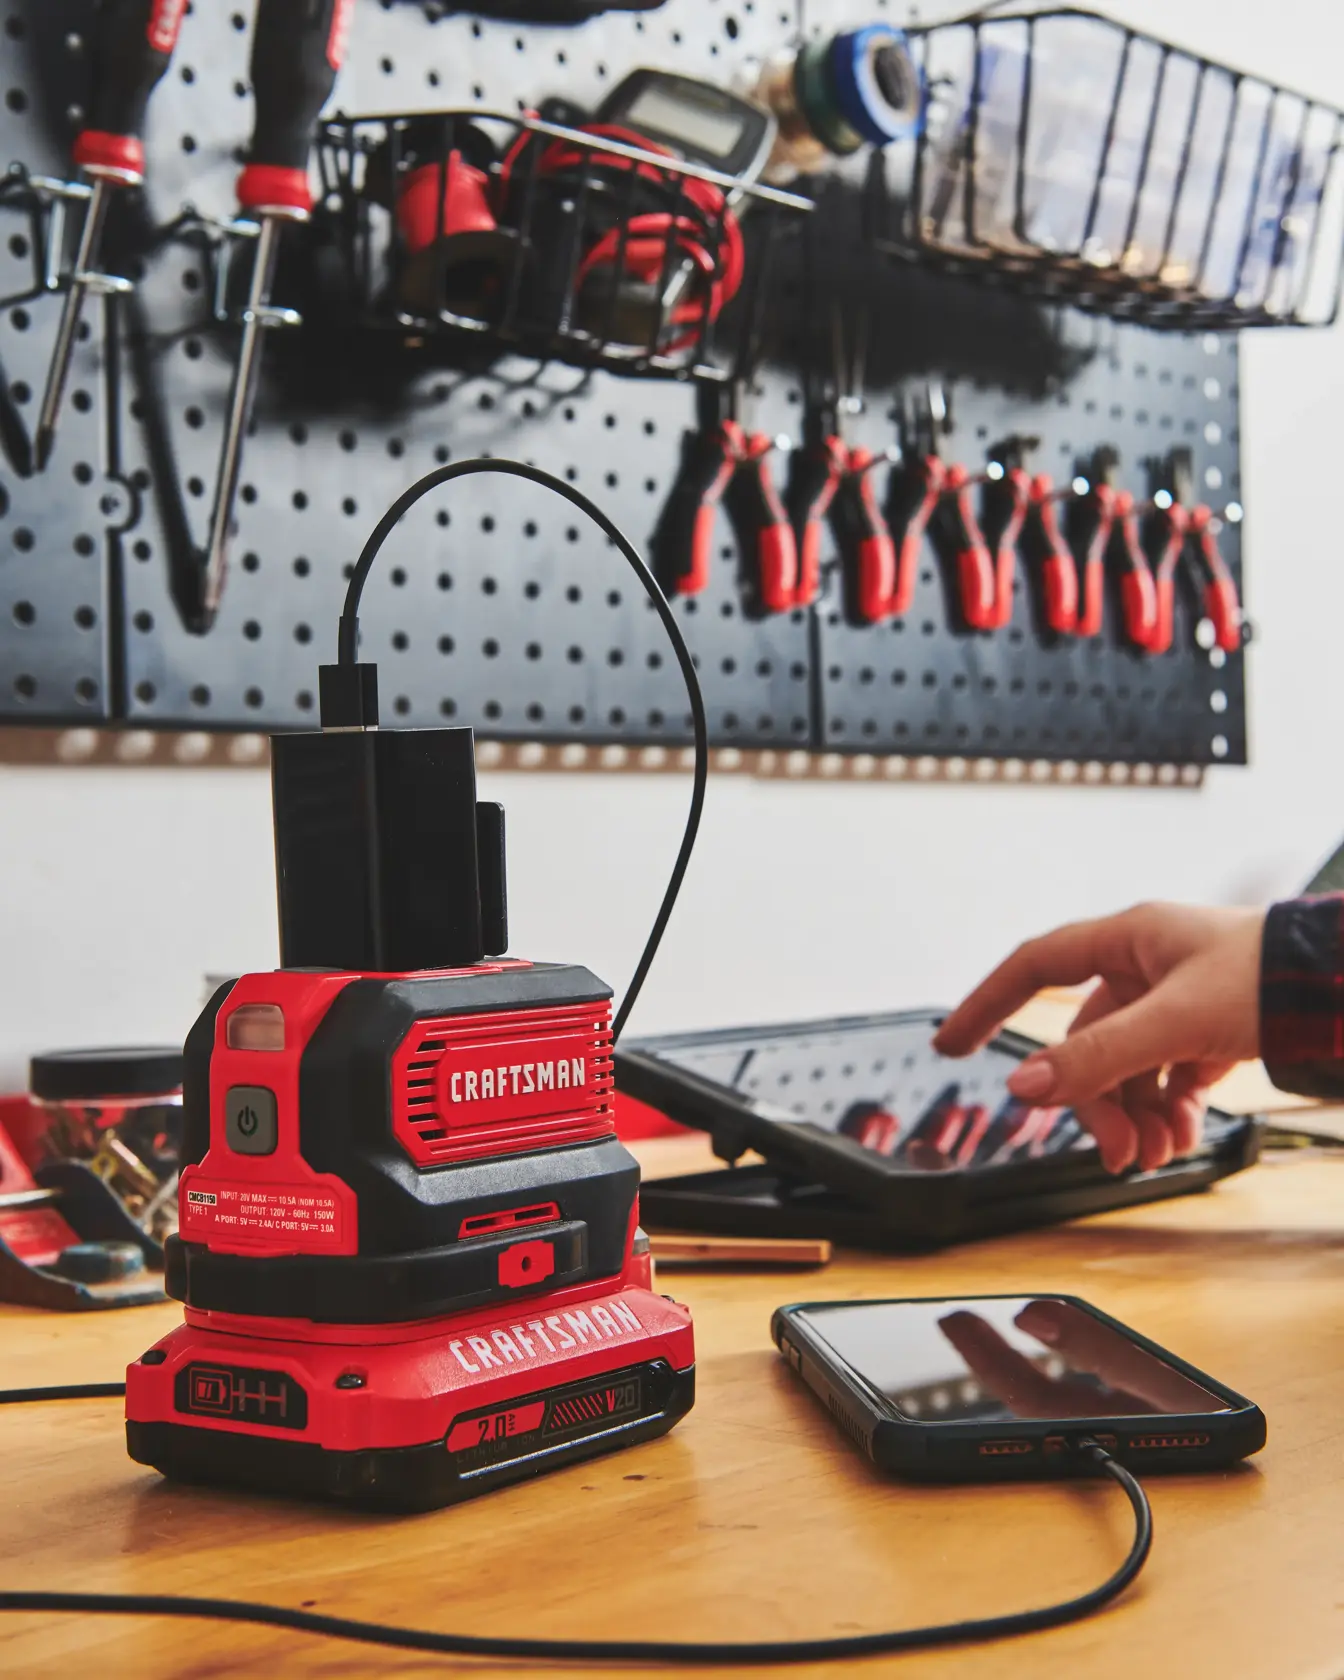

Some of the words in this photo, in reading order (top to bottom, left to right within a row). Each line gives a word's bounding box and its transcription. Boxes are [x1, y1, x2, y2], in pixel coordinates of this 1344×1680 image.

[451, 1057, 585, 1103] CRAFTSMAN
[188, 1191, 216, 1205] CMCB1150
[240, 1192, 251, 1202] 20V
[251, 1193, 267, 1203] MAX
[279, 1196, 296, 1205] 10.5A
[298, 1198, 315, 1207] (NOM
[316, 1199, 335, 1209] 10.5A)
[189, 1204, 203, 1215] TYPE
[204, 1206, 208, 1216] 1
[240, 1204, 269, 1216] OUTPUT:
[270, 1207, 286, 1217] 120V
[292, 1209, 310, 1219] 60Hz
[314, 1210, 335, 1220] 150W
[214, 1214, 220, 1222] A
[220, 1215, 239, 1225] PORT:
[240, 1217, 248, 1226] 5V
[275, 1220, 280, 1229] C
[281, 1221, 300, 1231] PORT:
[301, 1222, 309, 1231] 5V
[320, 1223, 335, 1233] 3.0A
[449, 1300, 642, 1373] CRAFTSMAN
[605, 1383, 635, 1412] V20
[477, 1414, 507, 1446] 2.0
[507, 1413, 516, 1432] AH
